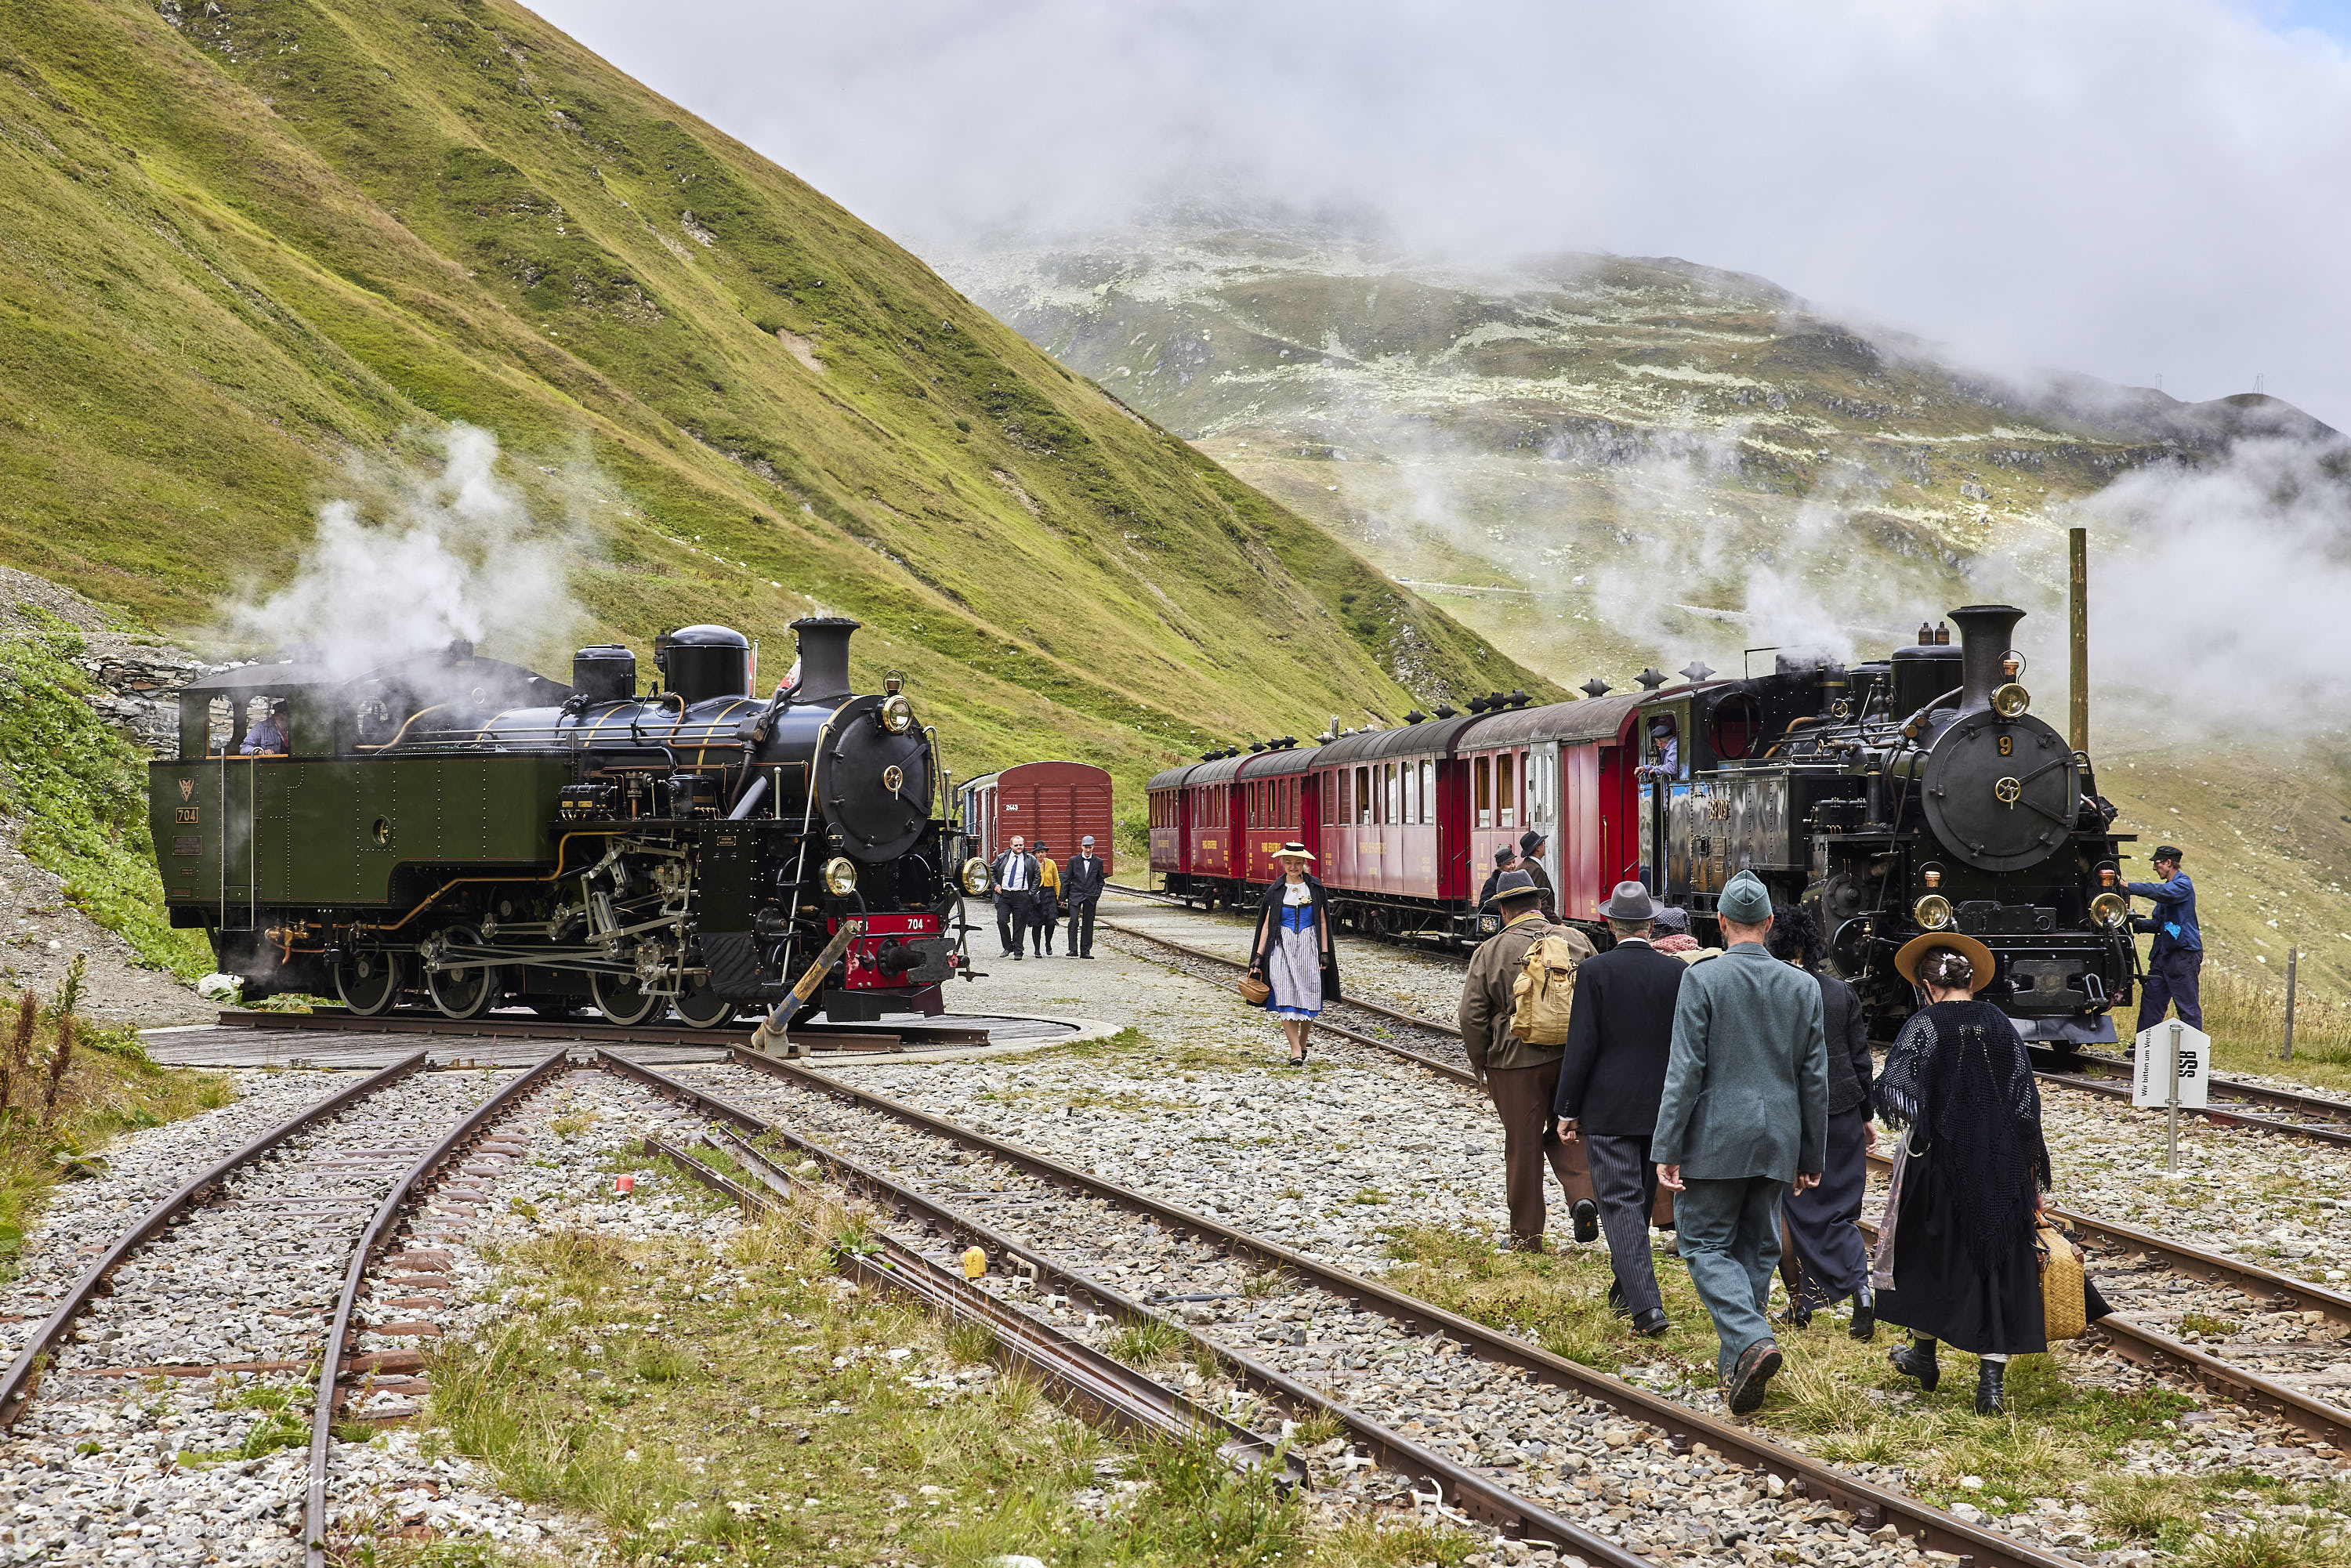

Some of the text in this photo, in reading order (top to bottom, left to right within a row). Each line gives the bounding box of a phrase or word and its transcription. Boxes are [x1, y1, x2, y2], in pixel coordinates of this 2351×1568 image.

[2000, 737, 2012, 755] 9
[178, 809, 196, 821] 704
[907, 918, 923, 929] 704
[2144, 1050, 2150, 1060] um
